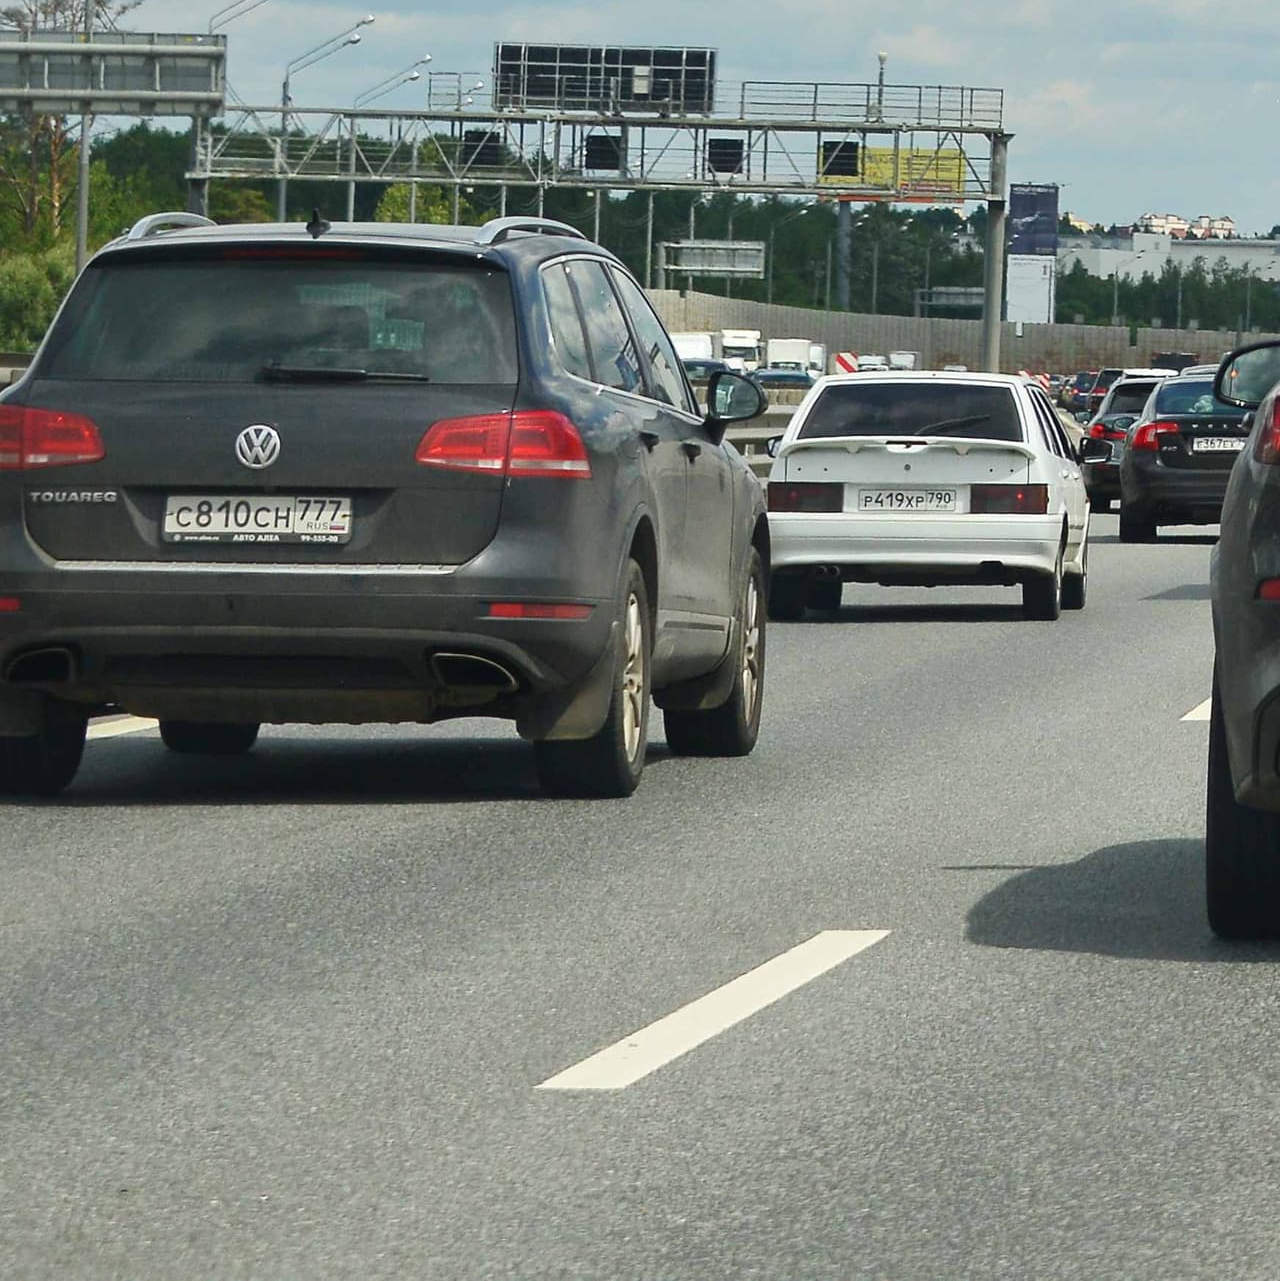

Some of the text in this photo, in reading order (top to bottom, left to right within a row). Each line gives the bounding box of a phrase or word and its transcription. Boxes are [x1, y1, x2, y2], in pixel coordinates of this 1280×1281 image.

[29, 490, 118, 503] TOUAREG
[927, 492, 951, 504] 790
[298, 498, 344, 522] 777
[305, 521, 329, 531] RUS
